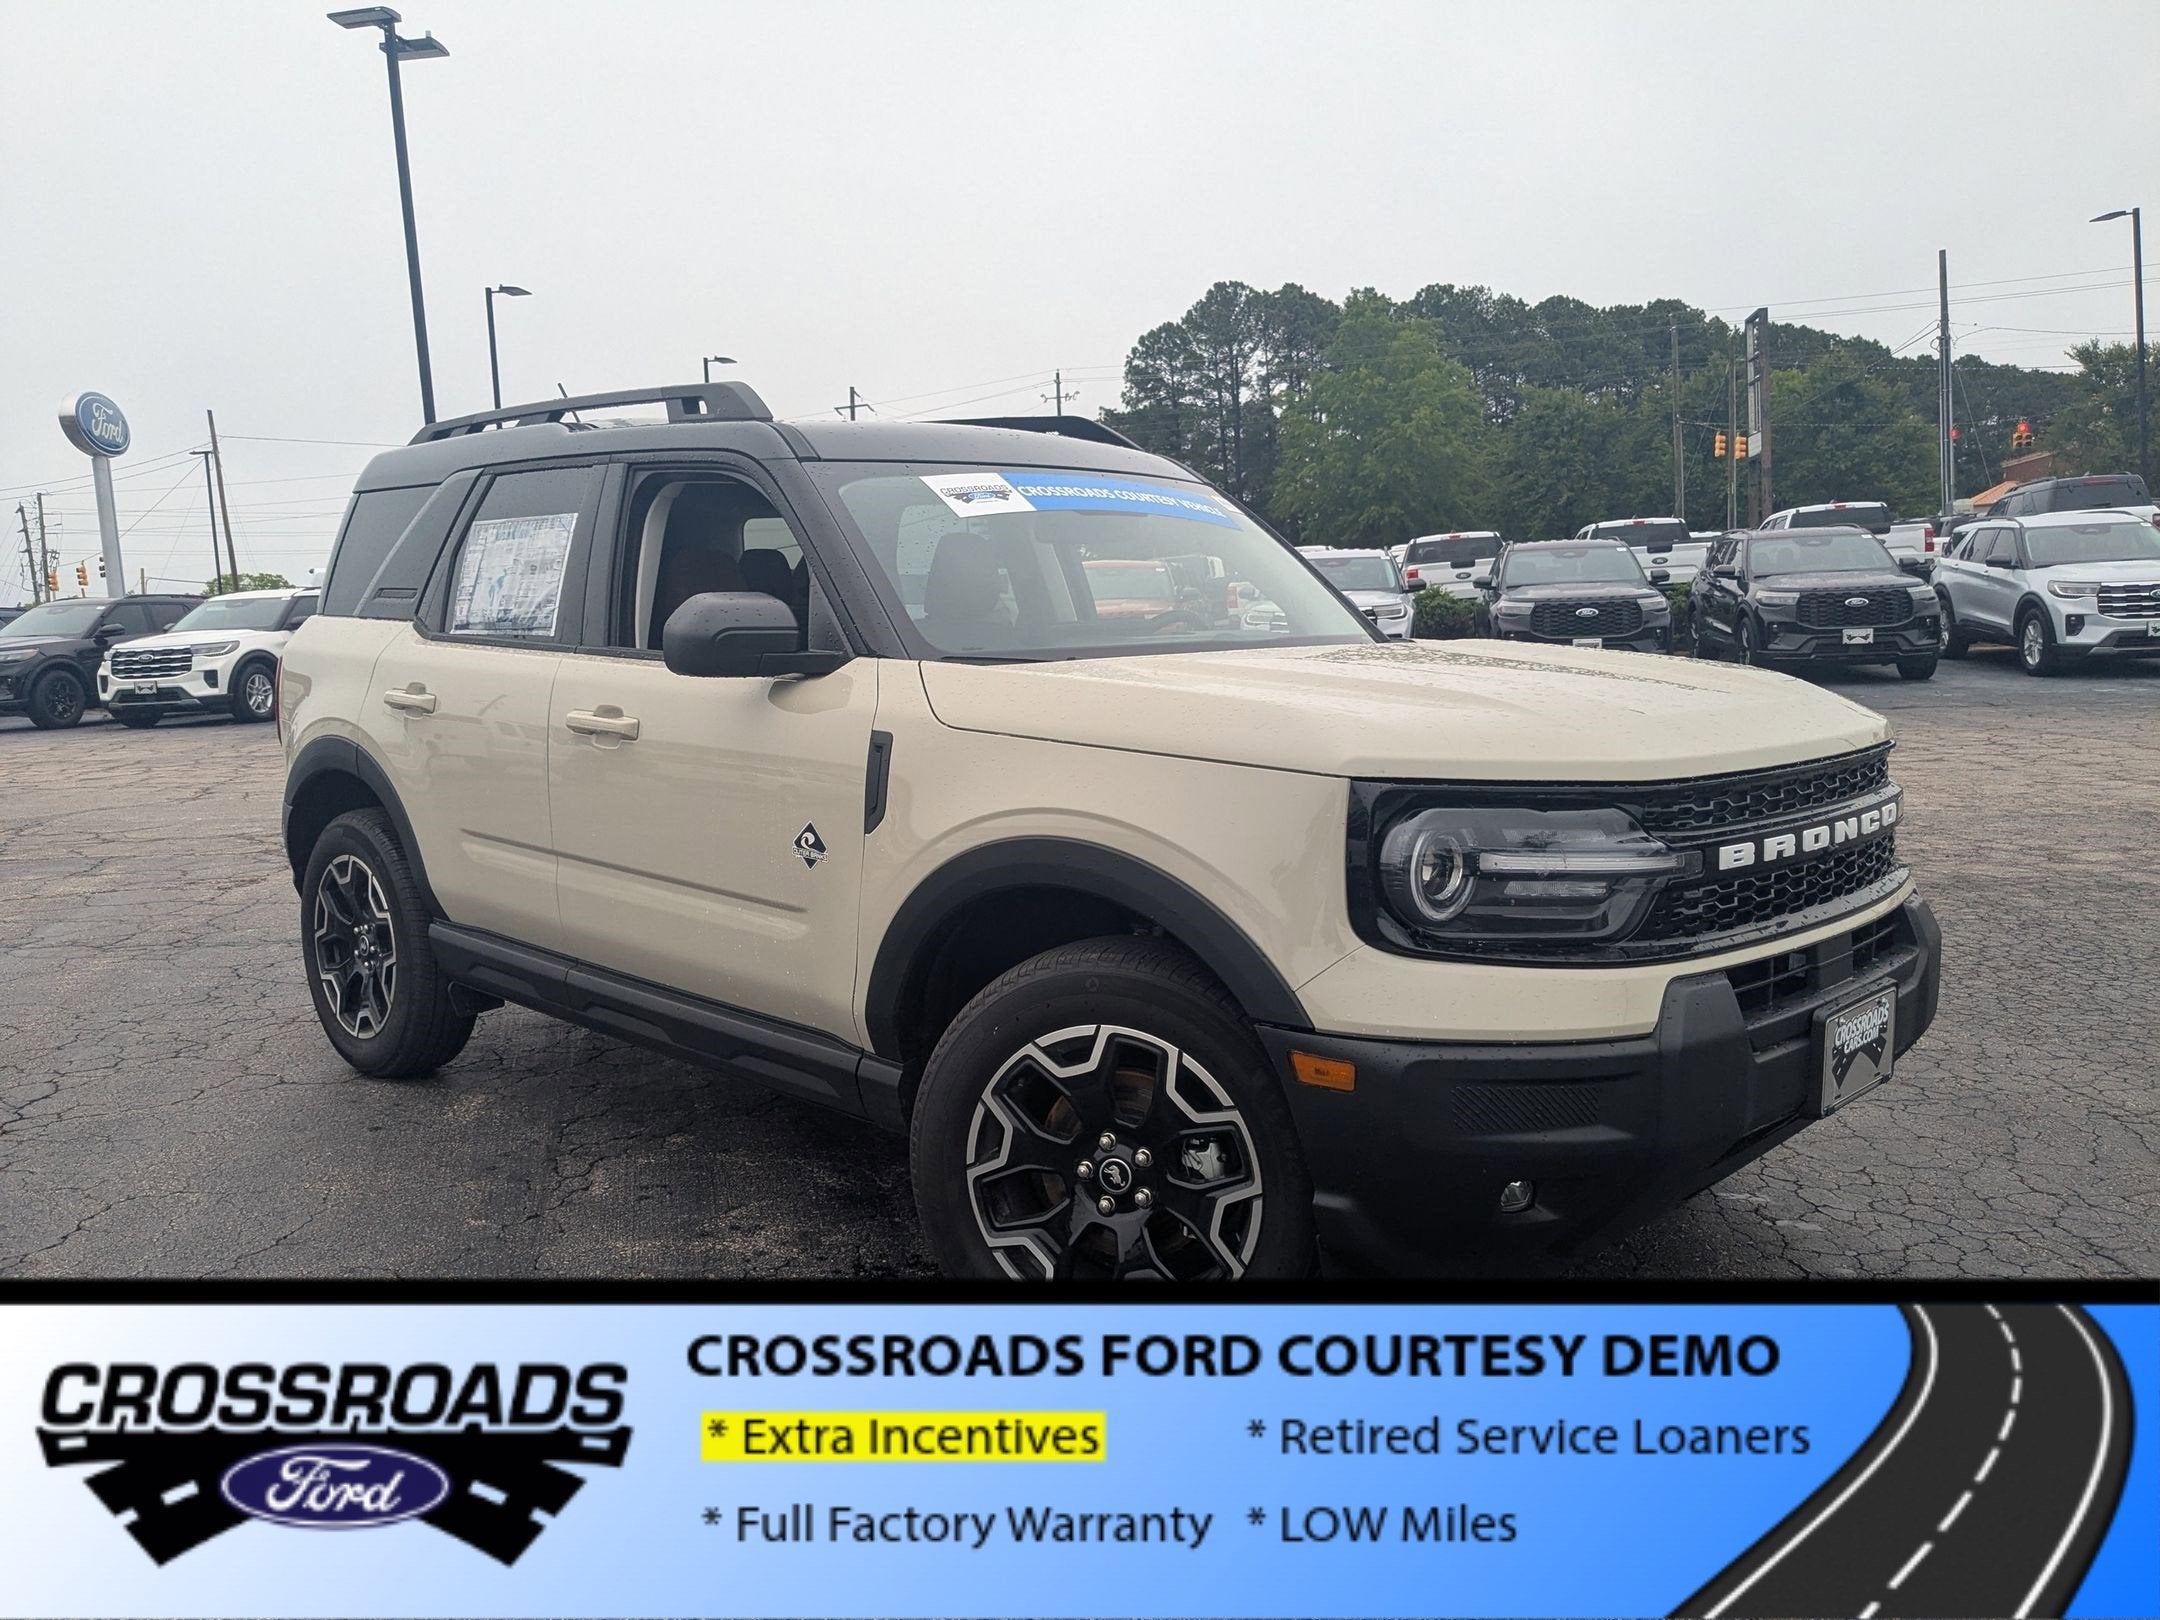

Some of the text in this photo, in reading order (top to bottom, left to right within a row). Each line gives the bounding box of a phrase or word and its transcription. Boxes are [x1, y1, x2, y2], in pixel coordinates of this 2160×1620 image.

[91, 402, 124, 444] Ford
[939, 484, 1010, 497] CROSSROADS
[1016, 485, 1116, 500] CROSSROADS
[1114, 489, 1181, 507] COURTESY
[1719, 802, 1898, 871] BRONCO
[1835, 1003, 1889, 1047] CROSSROADS
[1844, 1025, 1880, 1054] CARS.COM
